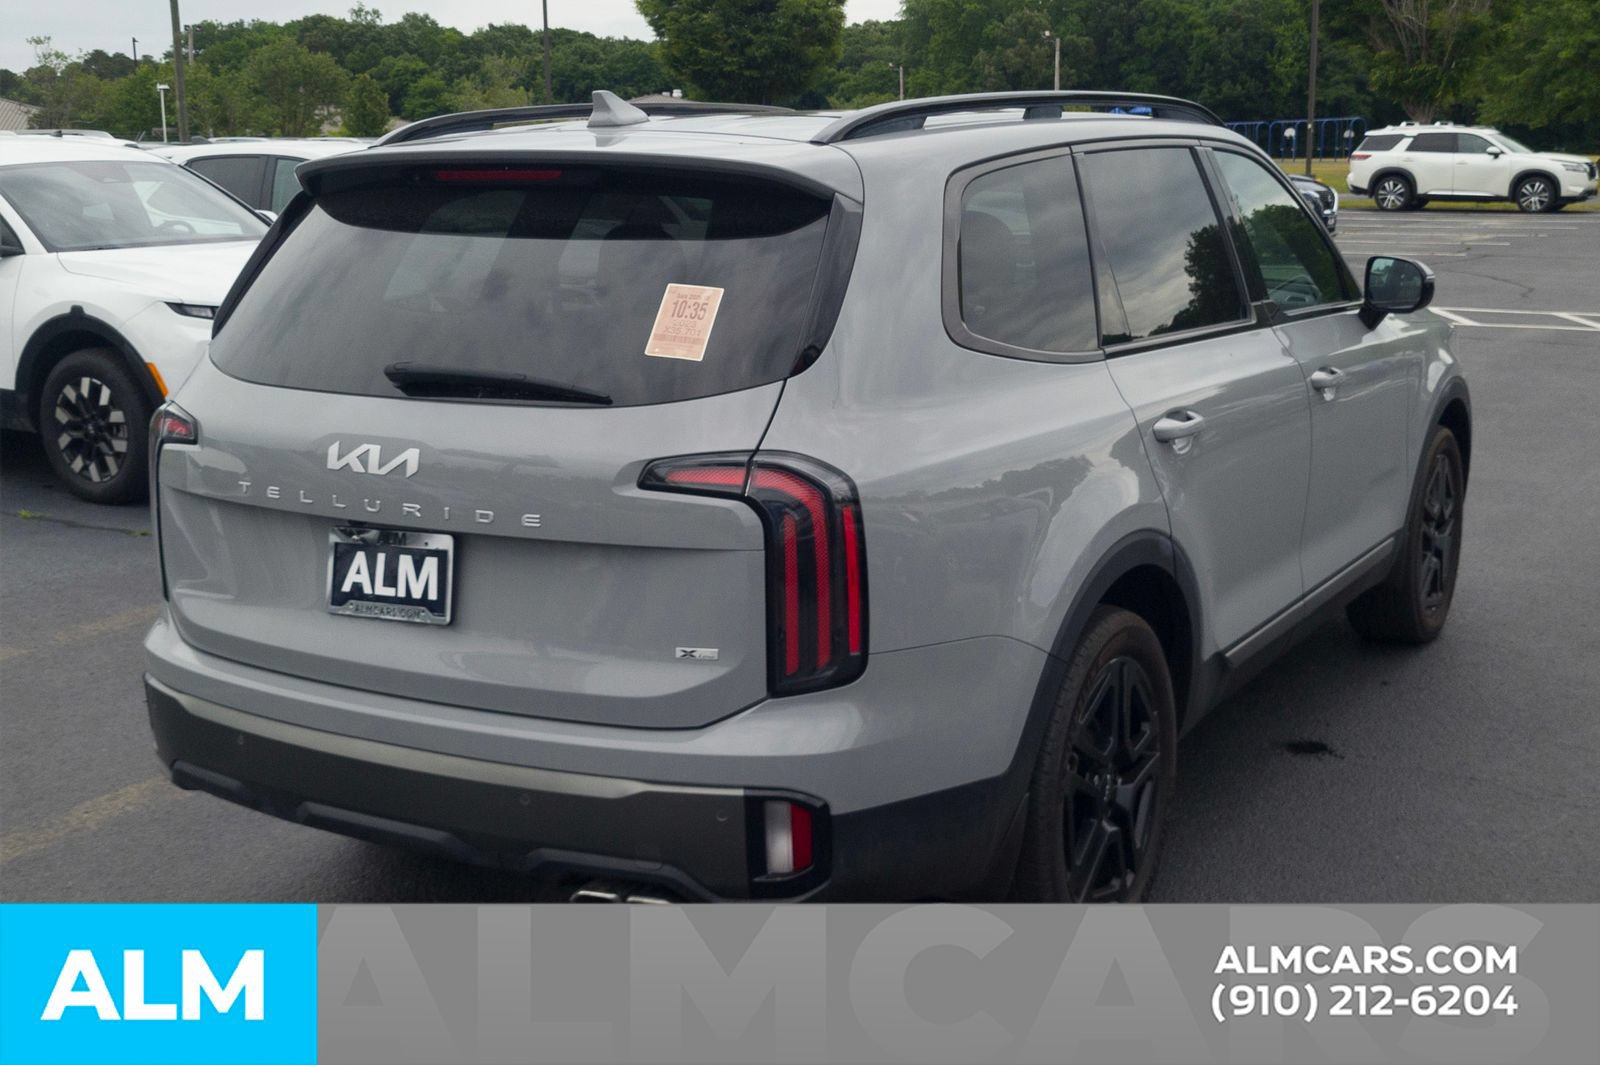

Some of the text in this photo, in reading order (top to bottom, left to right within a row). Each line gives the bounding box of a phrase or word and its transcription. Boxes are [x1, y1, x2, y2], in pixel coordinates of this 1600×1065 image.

[671, 299, 709, 320] 10:35
[326, 440, 420, 478] KIA
[238, 480, 542, 527] TELLURIDE
[341, 551, 439, 601] ALM
